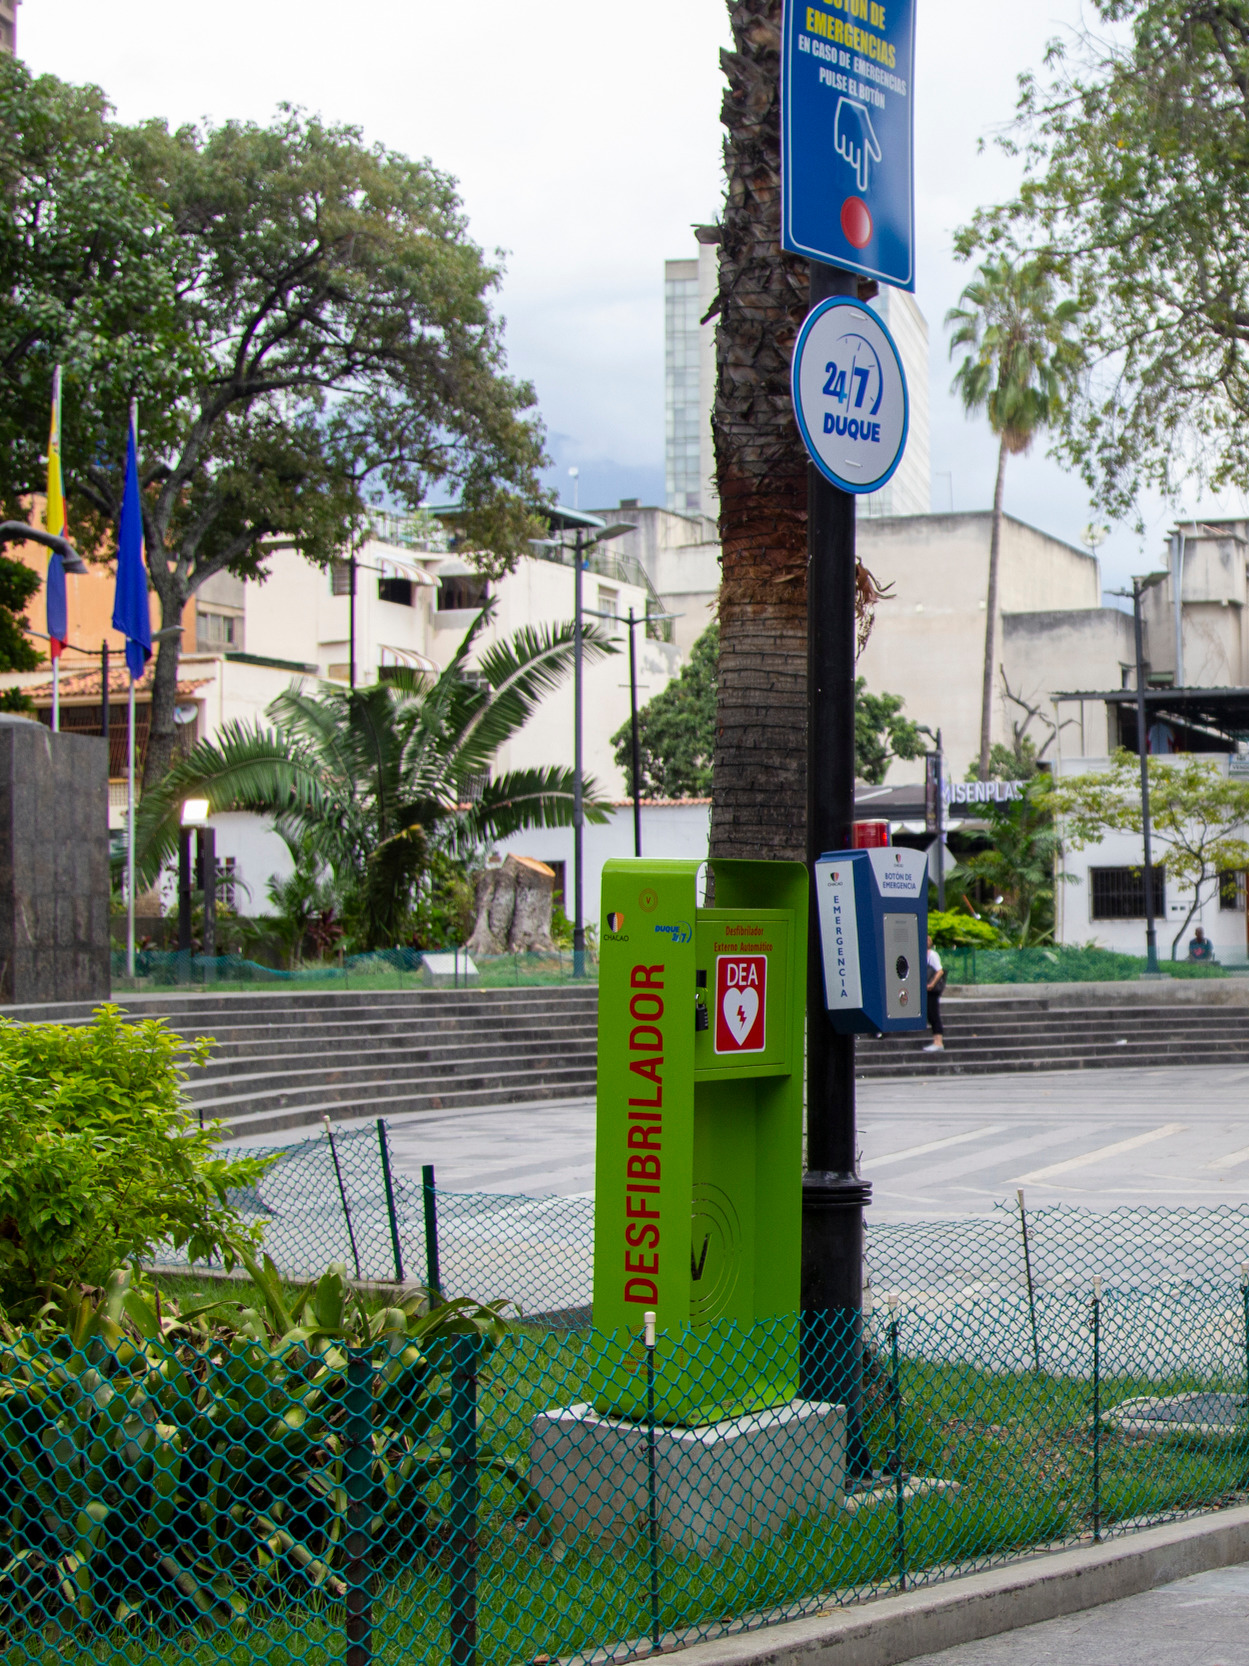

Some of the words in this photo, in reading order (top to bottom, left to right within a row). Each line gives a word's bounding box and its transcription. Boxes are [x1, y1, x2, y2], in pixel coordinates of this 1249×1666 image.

[871, 1, 885, 30] DE
[806, 6, 896, 69] EMERGENCIAS
[798, 33, 811, 53] EN
[812, 39, 838, 64] CASO
[839, 50, 851, 69] DE
[854, 56, 906, 96] EMERGENCIAS
[819, 66, 848, 92] PULSE
[848, 78, 858, 96] EL
[859, 83, 885, 109] BOTÓN
[823, 412, 881, 443] DUQUE
[882, 881, 917, 889] EMERGENCIA
[885, 871, 904, 880] BOTÓN
[603, 934, 629, 942] CHACAO
[655, 925, 680, 933] DUQUE
[725, 925, 764, 936] Desfibrilador
[714, 942, 738, 952] Externo
[740, 941, 773, 952] Automático
[727, 963, 759, 986] DEA
[624, 963, 665, 1306] DESFIBRILADOR
